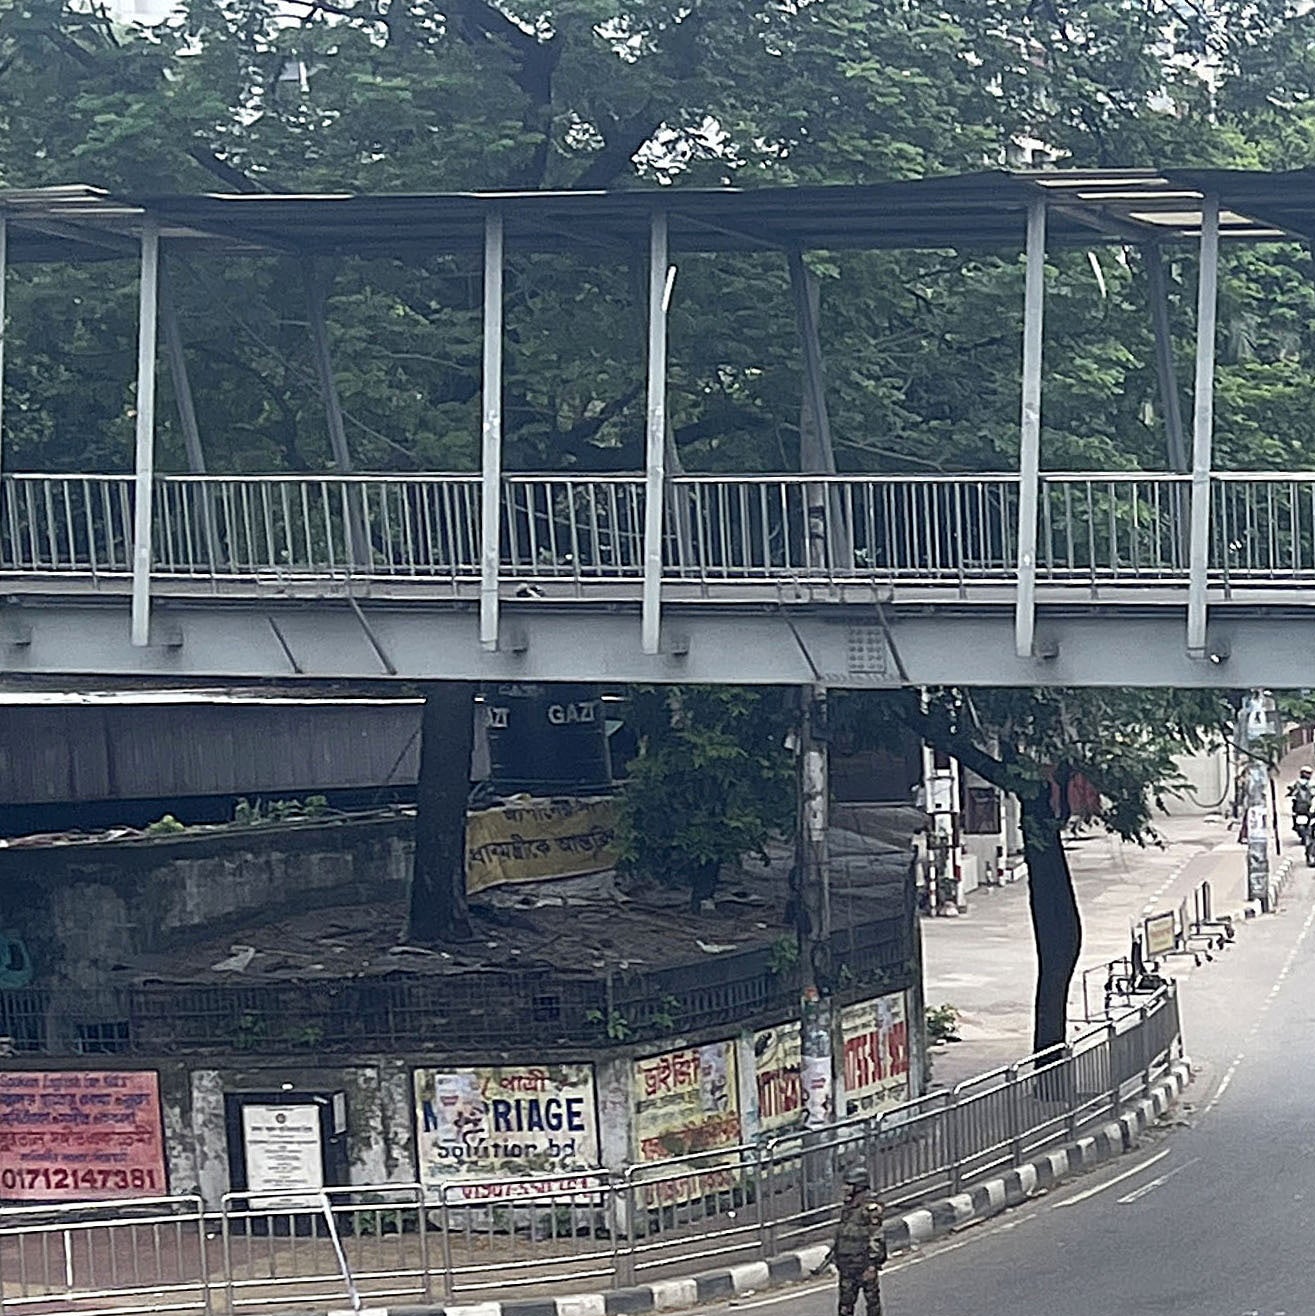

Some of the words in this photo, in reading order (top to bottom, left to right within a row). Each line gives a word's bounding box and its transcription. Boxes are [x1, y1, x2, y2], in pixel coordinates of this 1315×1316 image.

[548, 702, 596, 725] GAZI
[423, 1097, 586, 1133] MRIAGE
[2, 1166, 157, 1190] 01712147381
